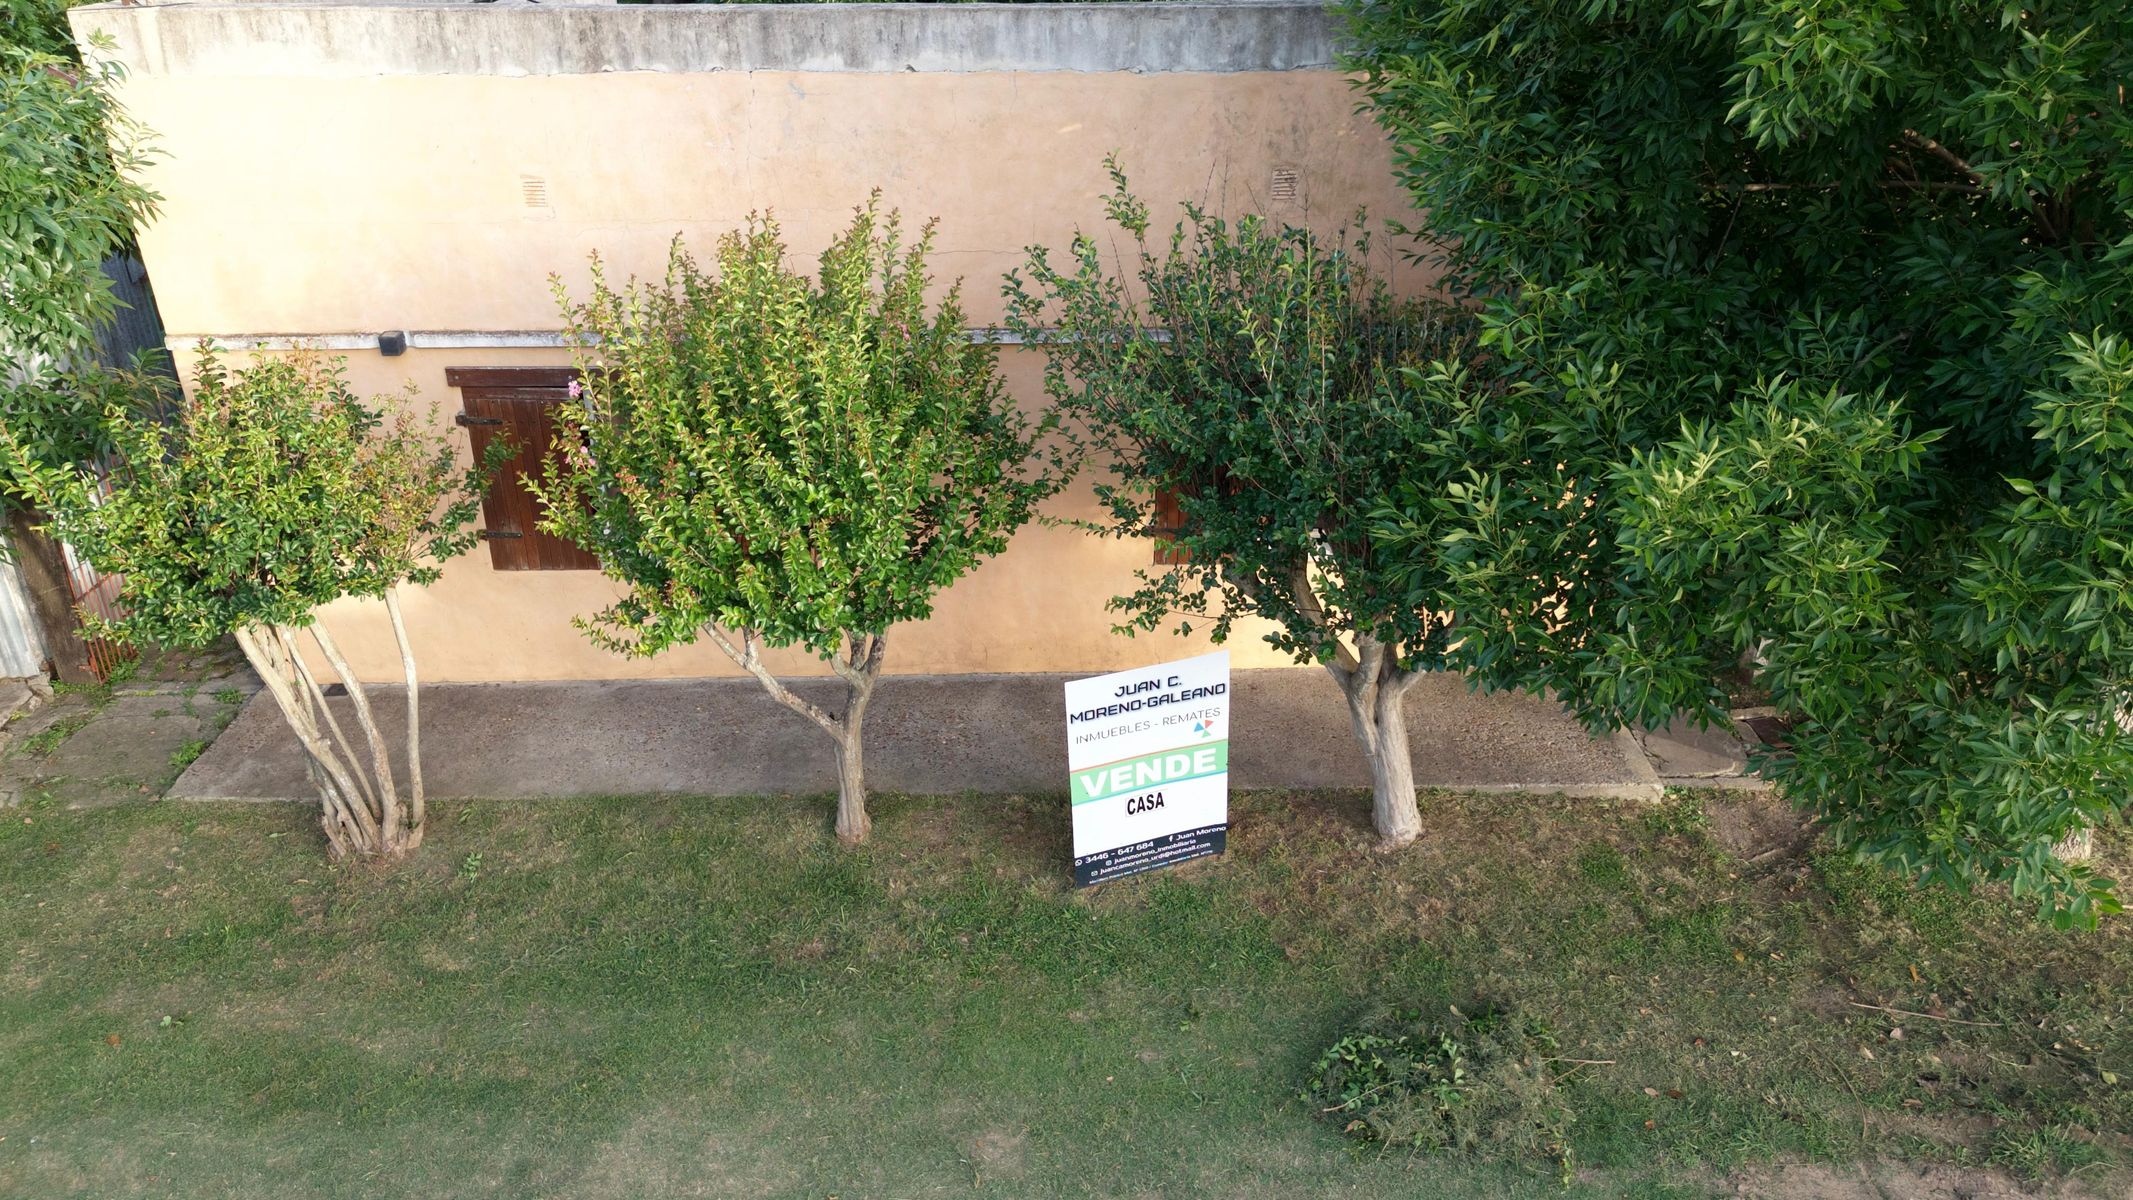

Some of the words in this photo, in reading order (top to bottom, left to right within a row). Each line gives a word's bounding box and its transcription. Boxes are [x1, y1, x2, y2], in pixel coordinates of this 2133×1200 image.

[1070, 683, 1226, 724] MORENO-GALEANO
[1114, 679, 1161, 697] JUAN
[1167, 675, 1182, 687] C.
[1076, 720, 1150, 744] INMUEBLES
[1162, 707, 1221, 726] REMATES
[1079, 748, 1217, 797] VENDE
[1127, 792, 1165, 815] CASA
[1085, 852, 1109, 864] 3446
[1117, 846, 1134, 855] 647
[1136, 841, 1154, 851] 684
[1176, 832, 1195, 841] Juan
[1196, 826, 1226, 836] Moreno
